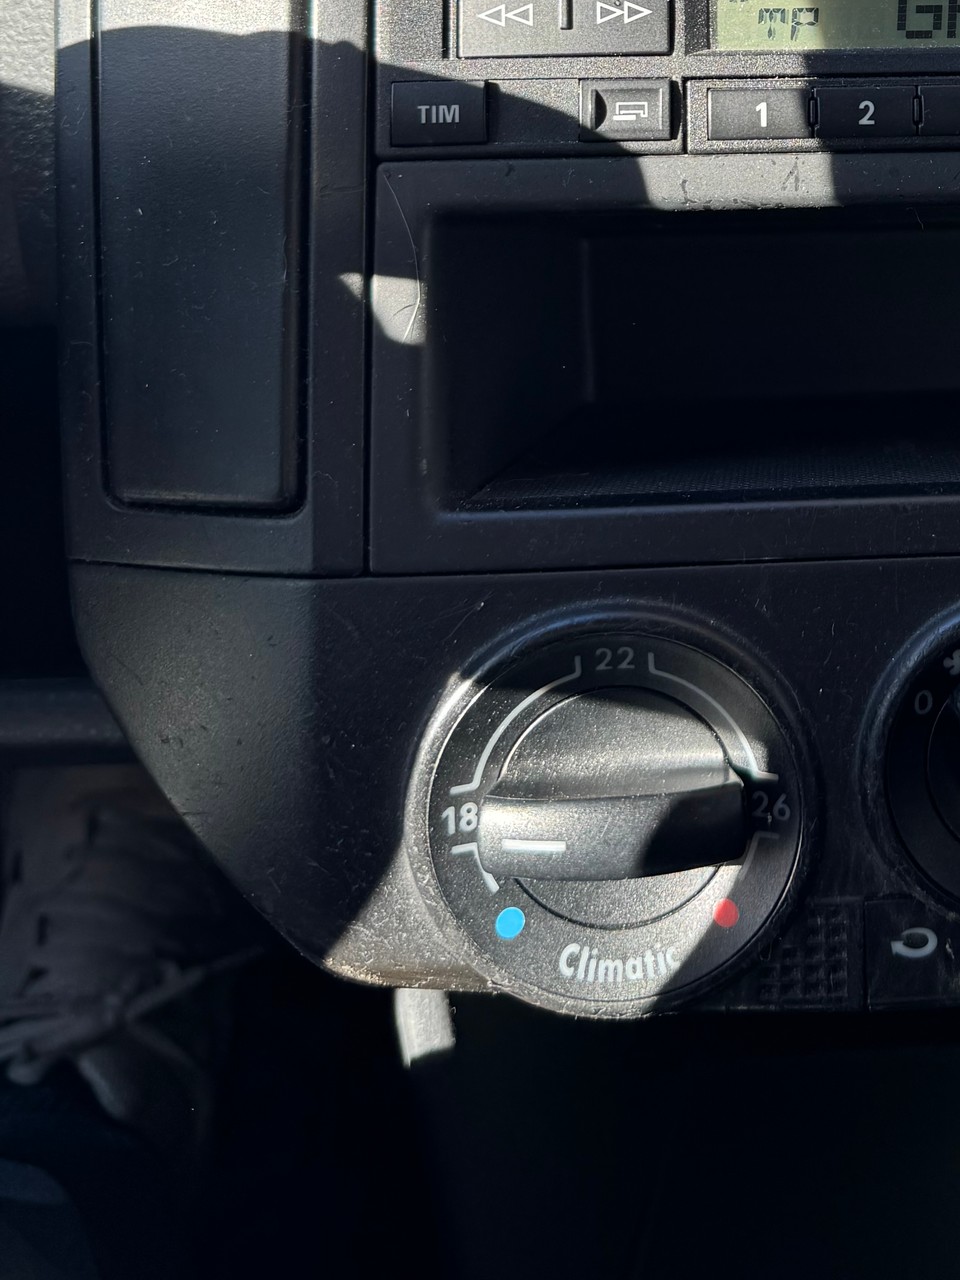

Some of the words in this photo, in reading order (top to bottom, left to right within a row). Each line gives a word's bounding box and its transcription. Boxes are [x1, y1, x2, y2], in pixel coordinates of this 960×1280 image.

[418, 104, 460, 124] TIM
[754, 102, 768, 128] 1
[858, 100, 875, 125] 2
[594, 647, 636, 671] 22
[914, 689, 933, 715] 0
[441, 804, 478, 834] 18
[753, 793, 791, 821] 26
[559, 942, 681, 982] Climatic
